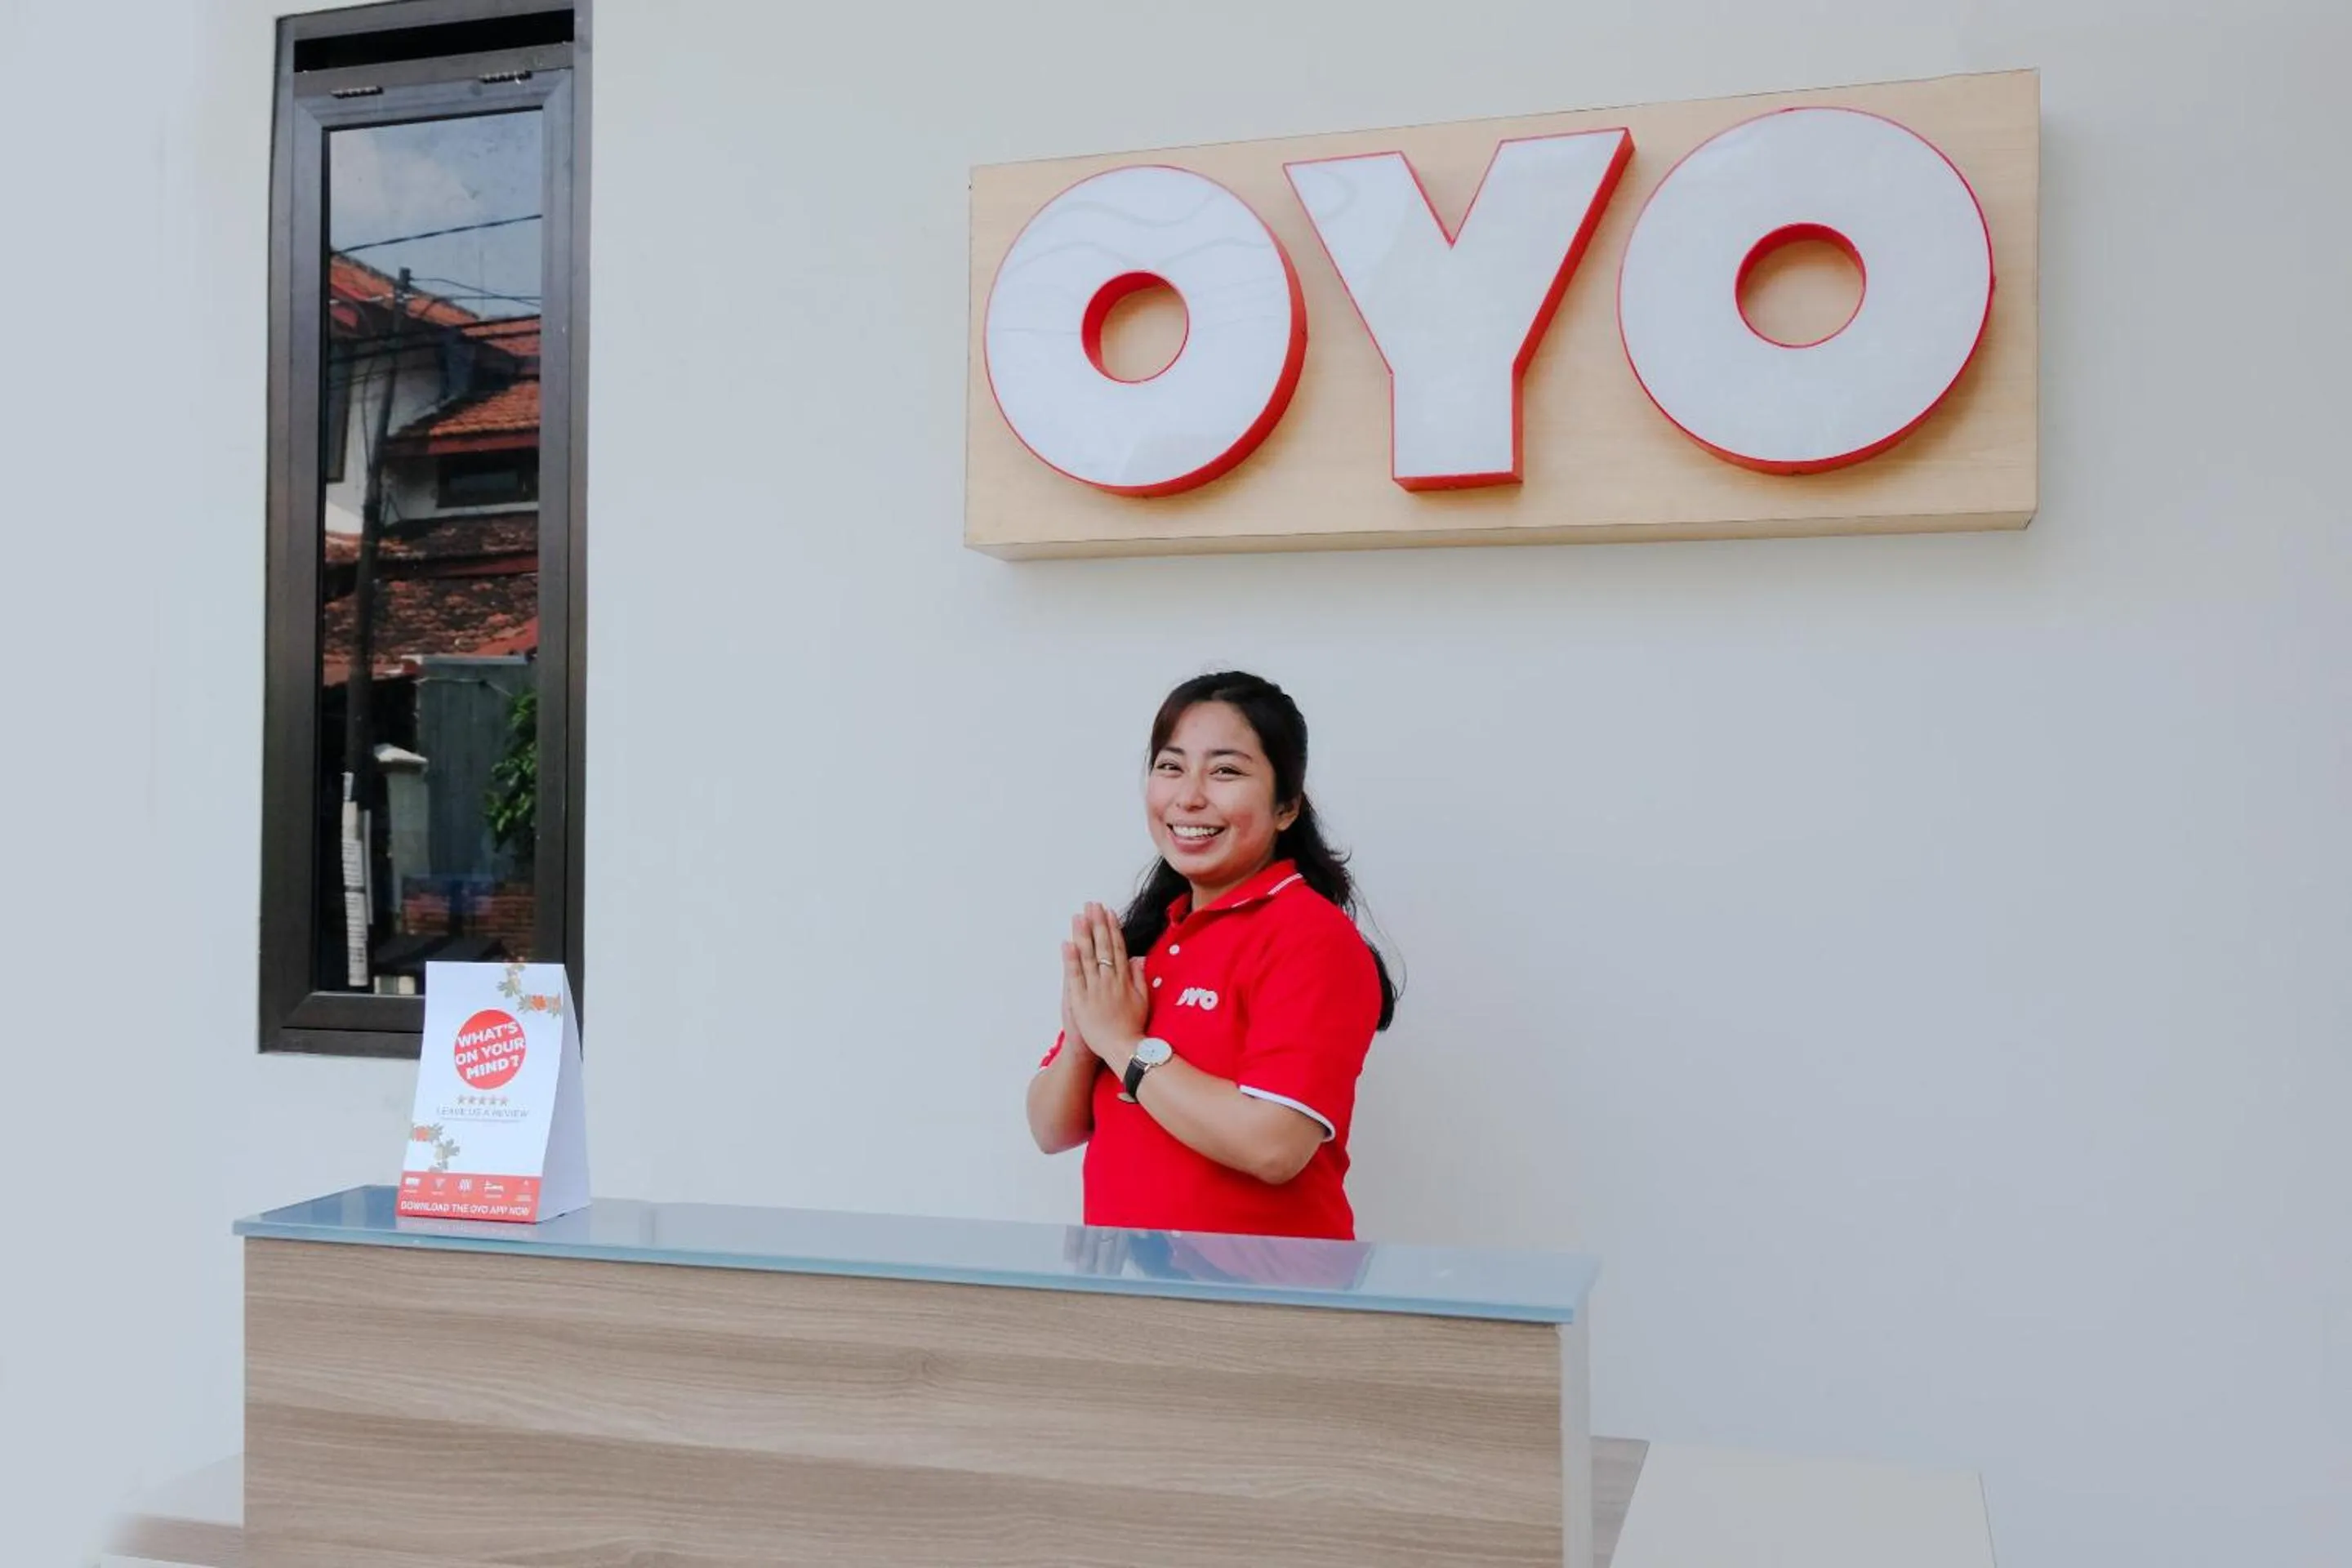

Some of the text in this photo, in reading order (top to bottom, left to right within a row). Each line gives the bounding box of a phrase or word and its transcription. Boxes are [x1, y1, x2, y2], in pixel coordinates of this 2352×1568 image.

[983, 106, 1995, 498] OYO
[457, 1021, 519, 1048] WHAT'S
[456, 1036, 526, 1066] ON YOUR
[400, 1200, 531, 1217] DOWNLOAD THE OYO APP NOW
